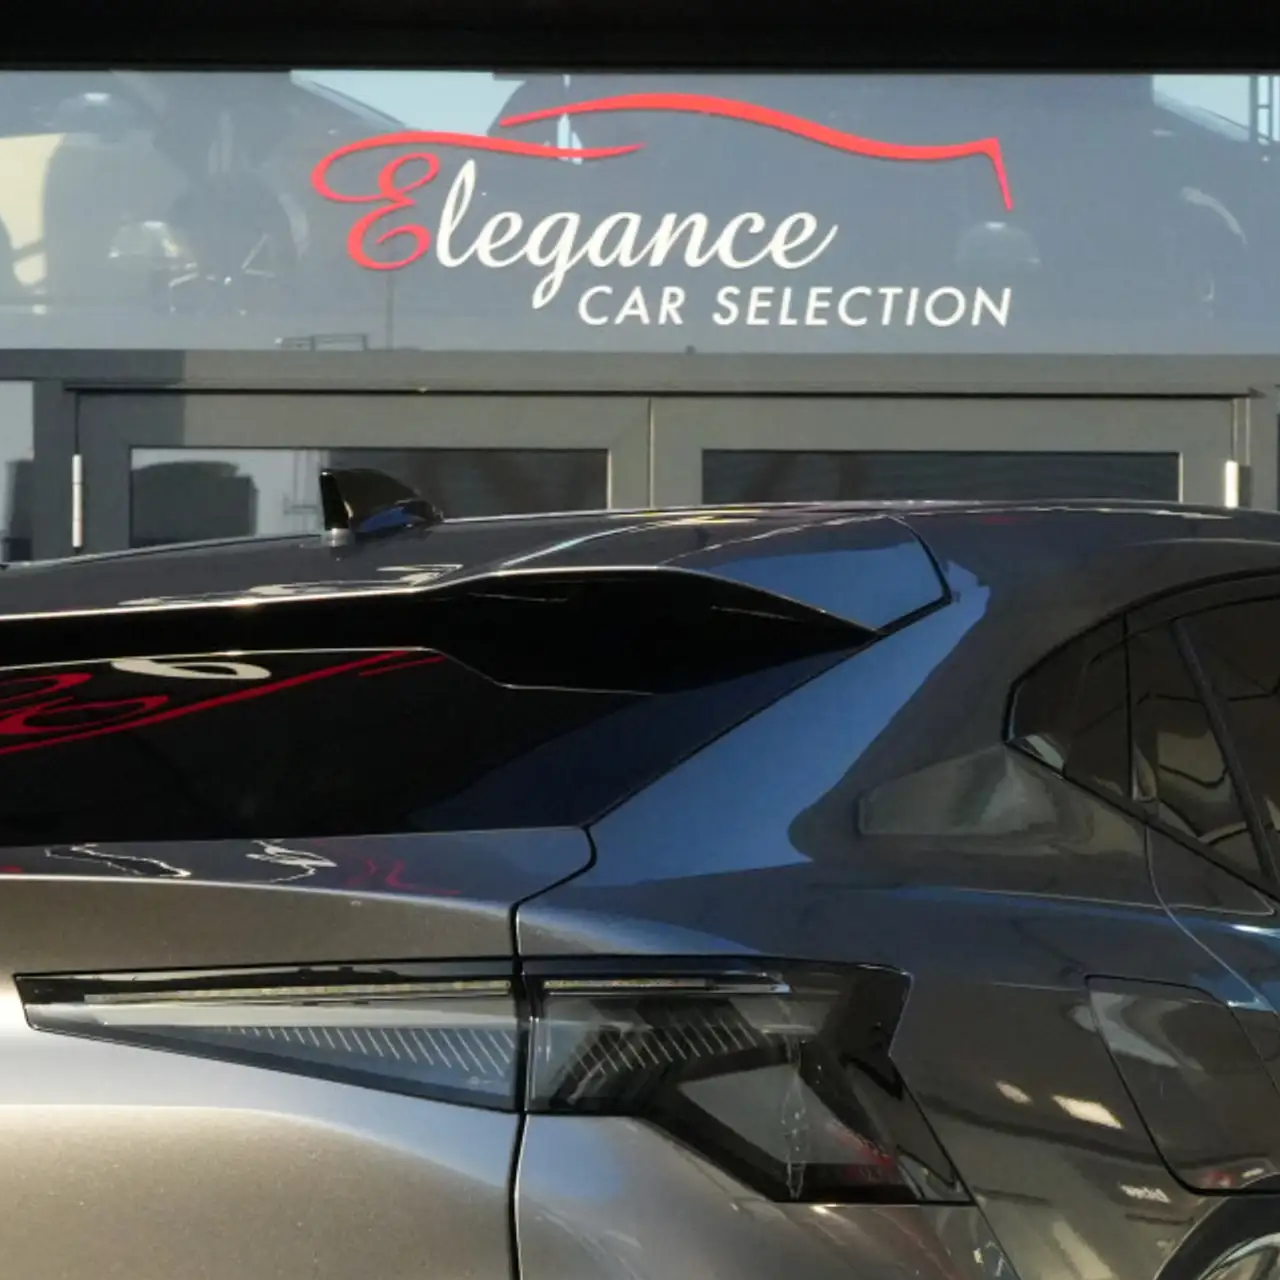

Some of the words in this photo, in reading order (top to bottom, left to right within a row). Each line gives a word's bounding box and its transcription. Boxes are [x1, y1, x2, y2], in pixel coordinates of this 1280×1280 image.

[311, 133, 839, 311] Elegance
[578, 285, 687, 326] CAR
[712, 285, 1012, 327] SELECTION
